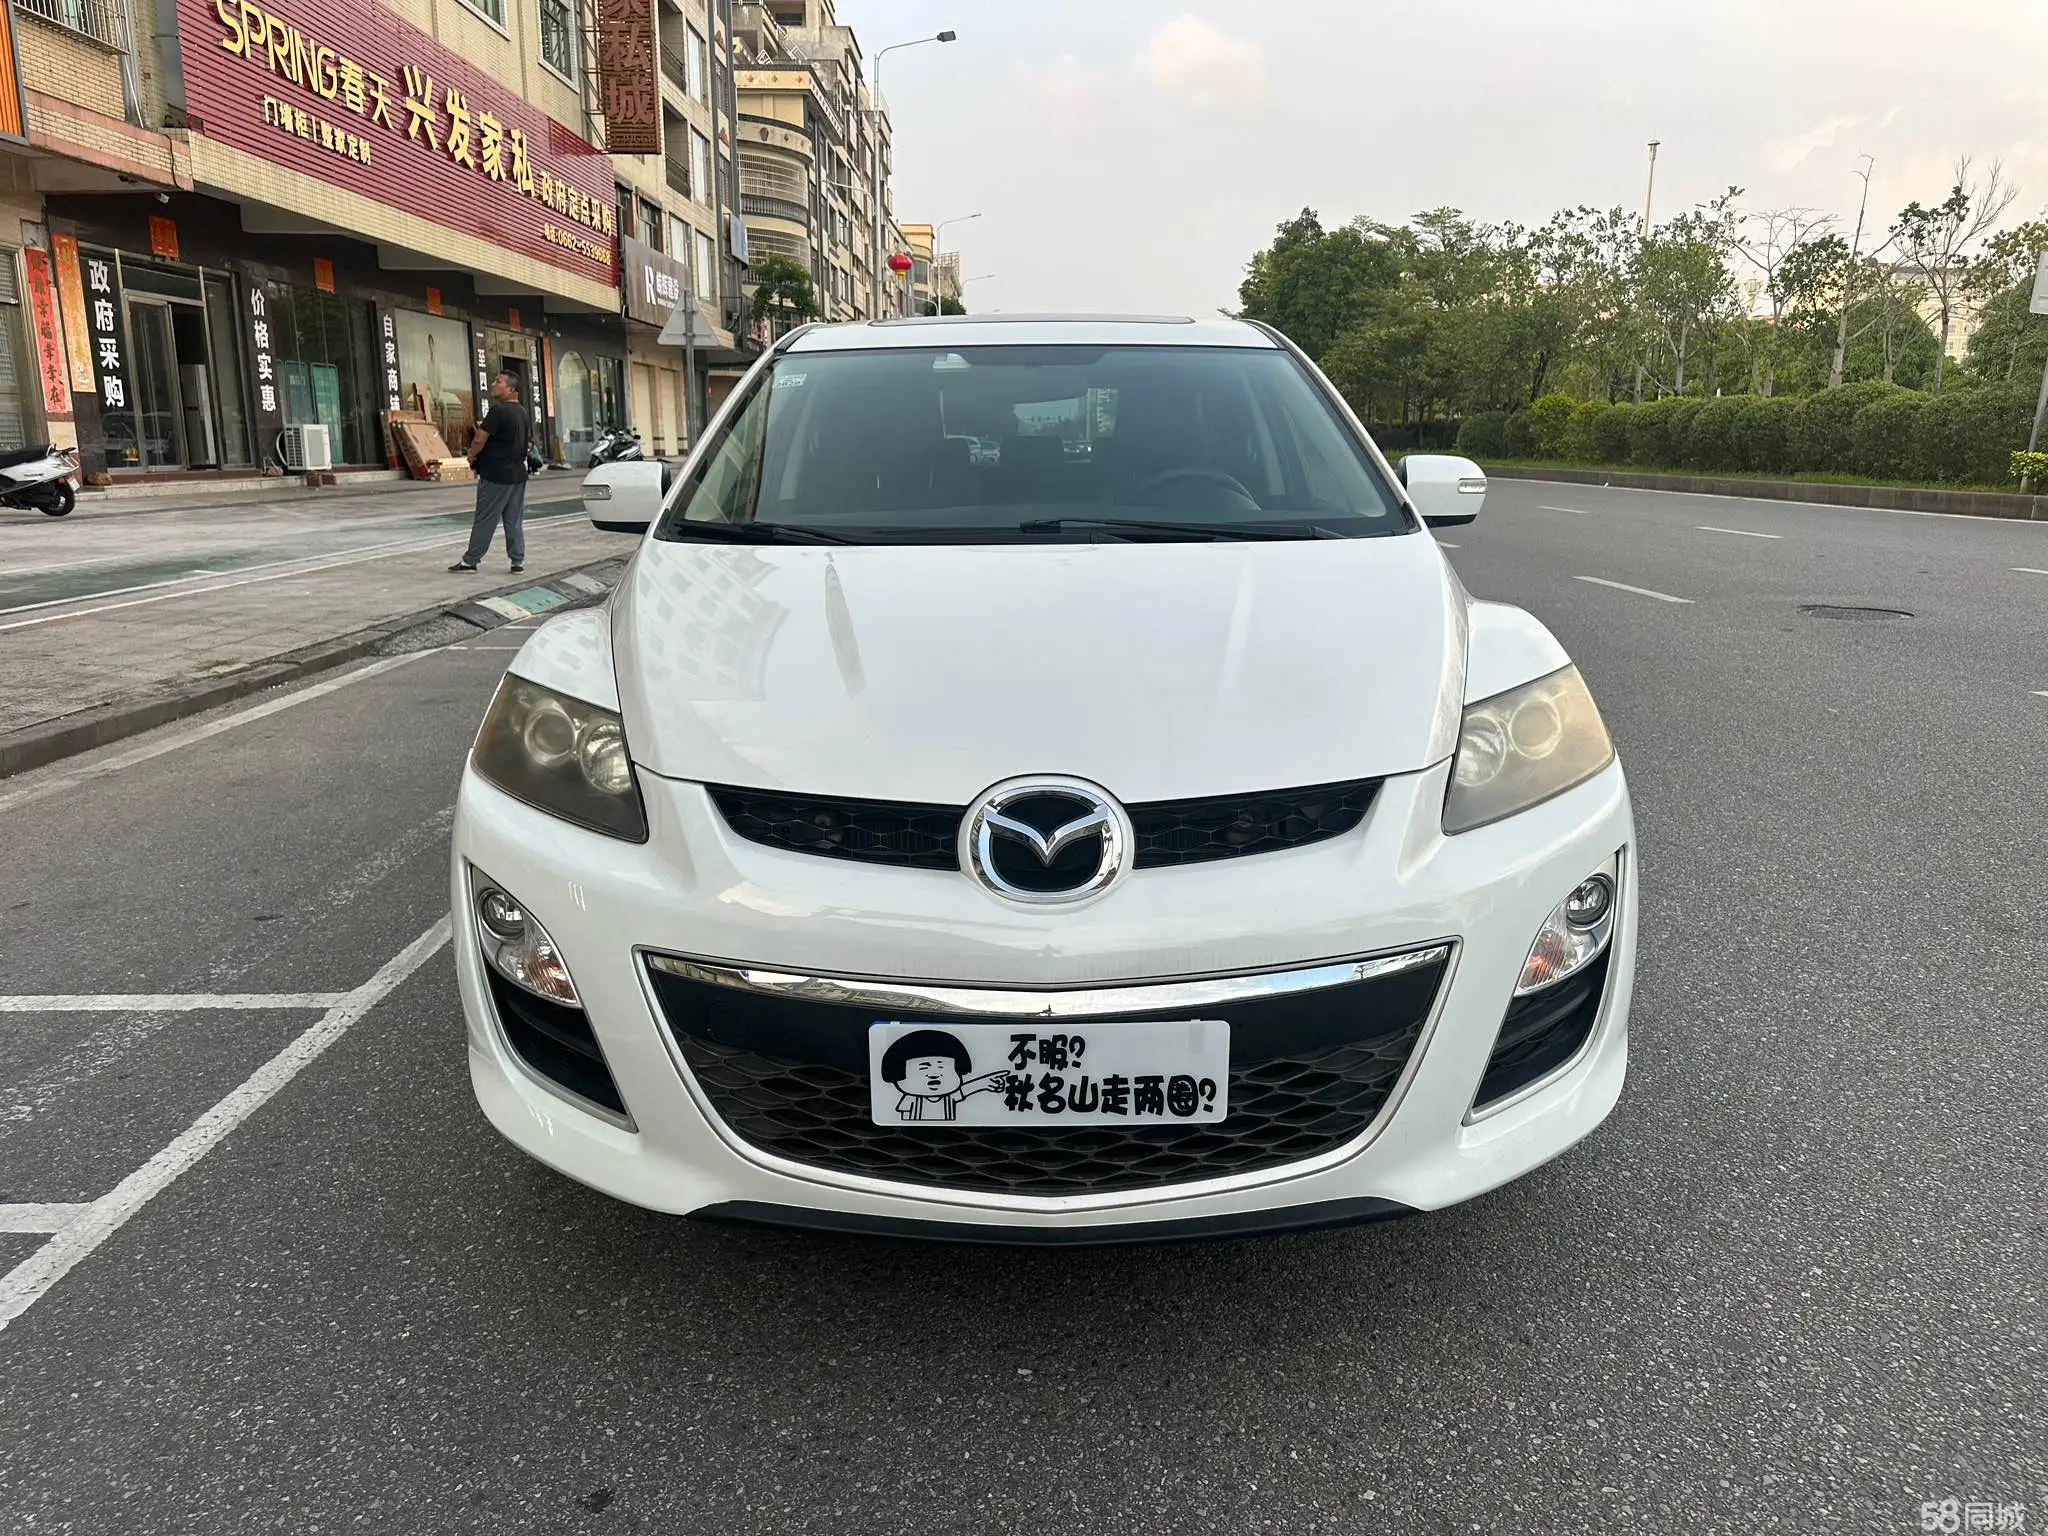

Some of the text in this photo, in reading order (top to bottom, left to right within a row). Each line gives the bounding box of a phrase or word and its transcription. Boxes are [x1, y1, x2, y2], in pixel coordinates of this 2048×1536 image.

[404, 65, 536, 198] 兴发家私
[540, 171, 612, 237] 政府定点采购
[88, 259, 125, 408] 政府采购
[250, 287, 277, 412] 价格实惠
[1003, 1073, 1217, 1118] 秋名山走两圈?
